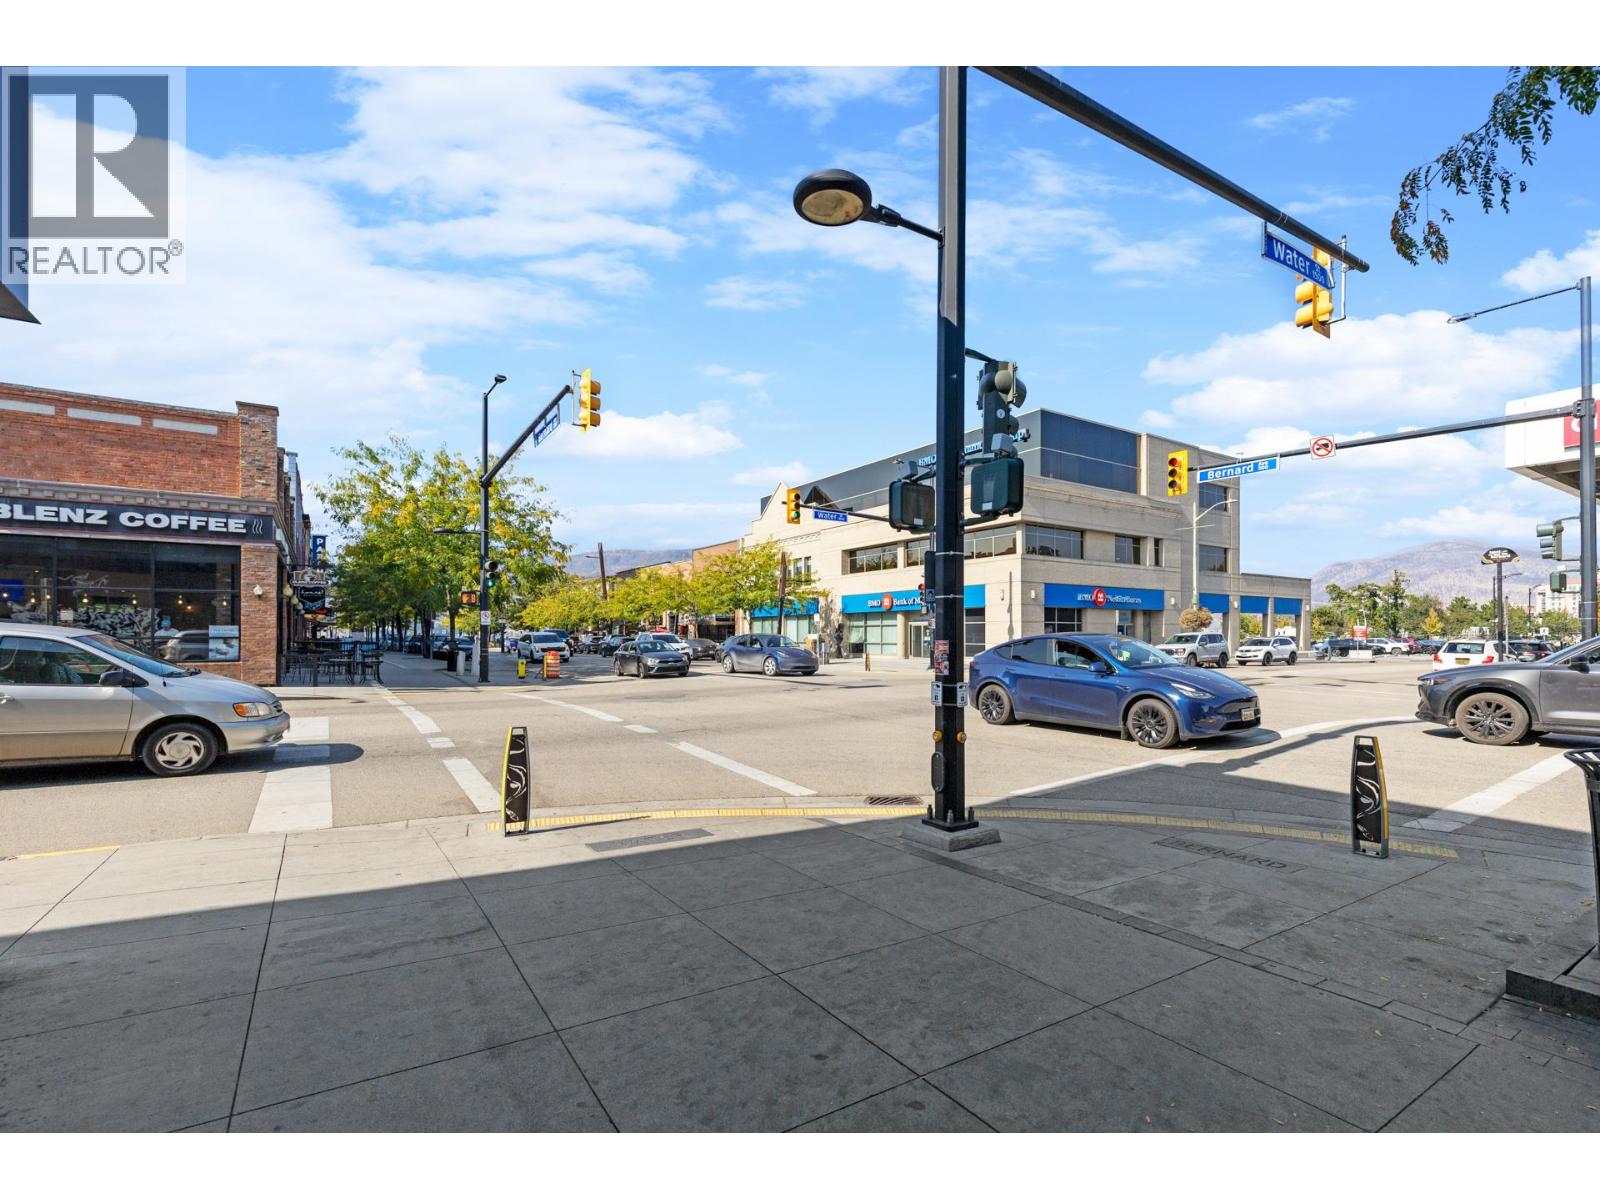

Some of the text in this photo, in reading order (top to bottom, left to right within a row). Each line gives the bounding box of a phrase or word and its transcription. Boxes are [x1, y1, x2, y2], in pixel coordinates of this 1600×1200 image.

[1273, 239, 1311, 276] Water
[1207, 463, 1254, 480] Bernard
[0, 504, 247, 534] BLENZ COFFEE
[817, 511, 837, 521] Water
[867, 600, 882, 608] BMO
[893, 597, 906, 607] Bank
